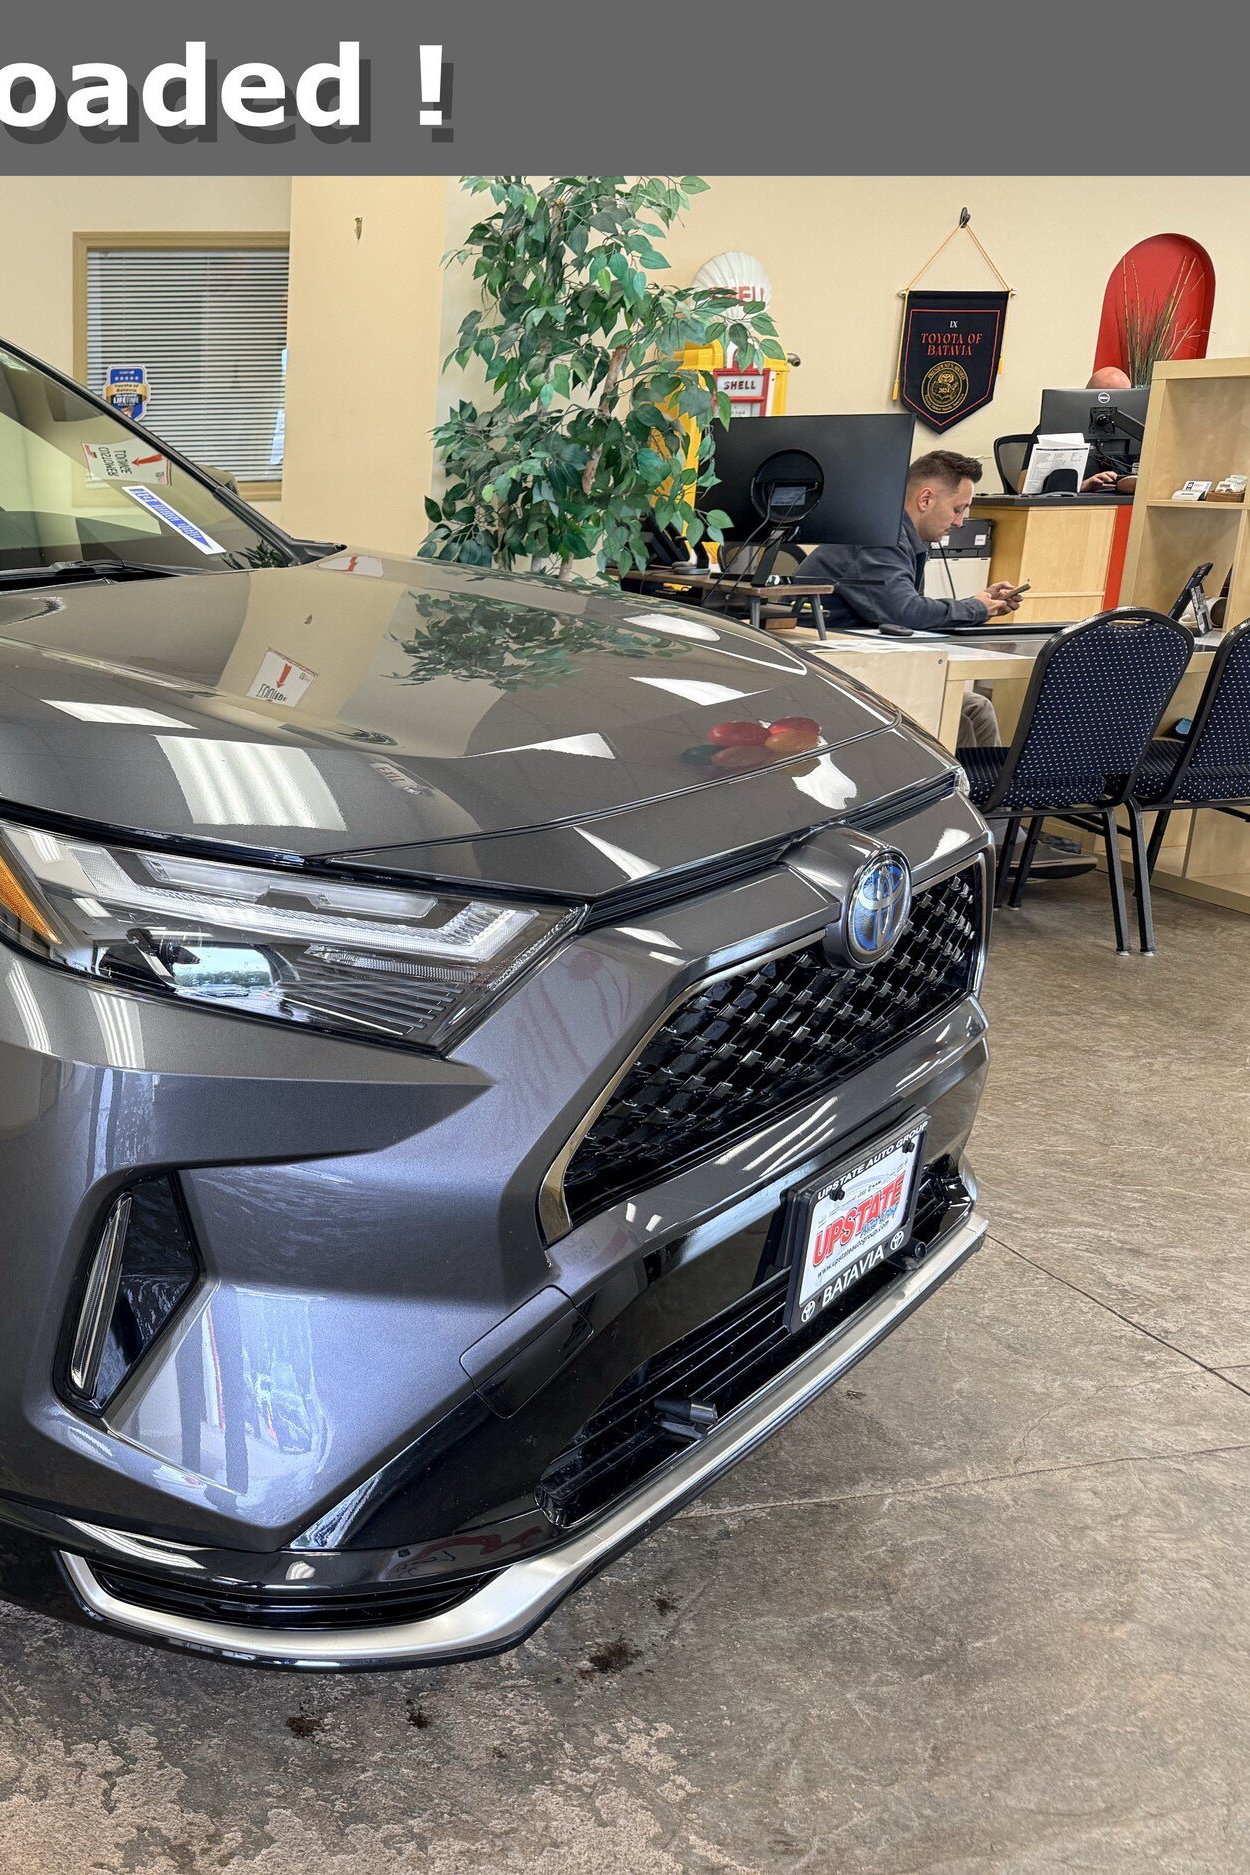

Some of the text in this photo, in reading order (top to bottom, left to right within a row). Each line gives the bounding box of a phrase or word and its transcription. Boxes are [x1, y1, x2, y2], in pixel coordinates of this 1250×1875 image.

[950, 320, 958, 328] IX
[921, 332, 983, 344] TOYOTA OF
[927, 344, 972, 356] BATAVIA
[723, 381, 756, 390] SHELL
[817, 1163, 867, 1201] UPSTATE
[866, 1146, 894, 1169] AUTO
[896, 1120, 929, 1148] GROUP
[813, 1170, 907, 1267] UPSTATE
[821, 1245, 885, 1308] BATAVIA
